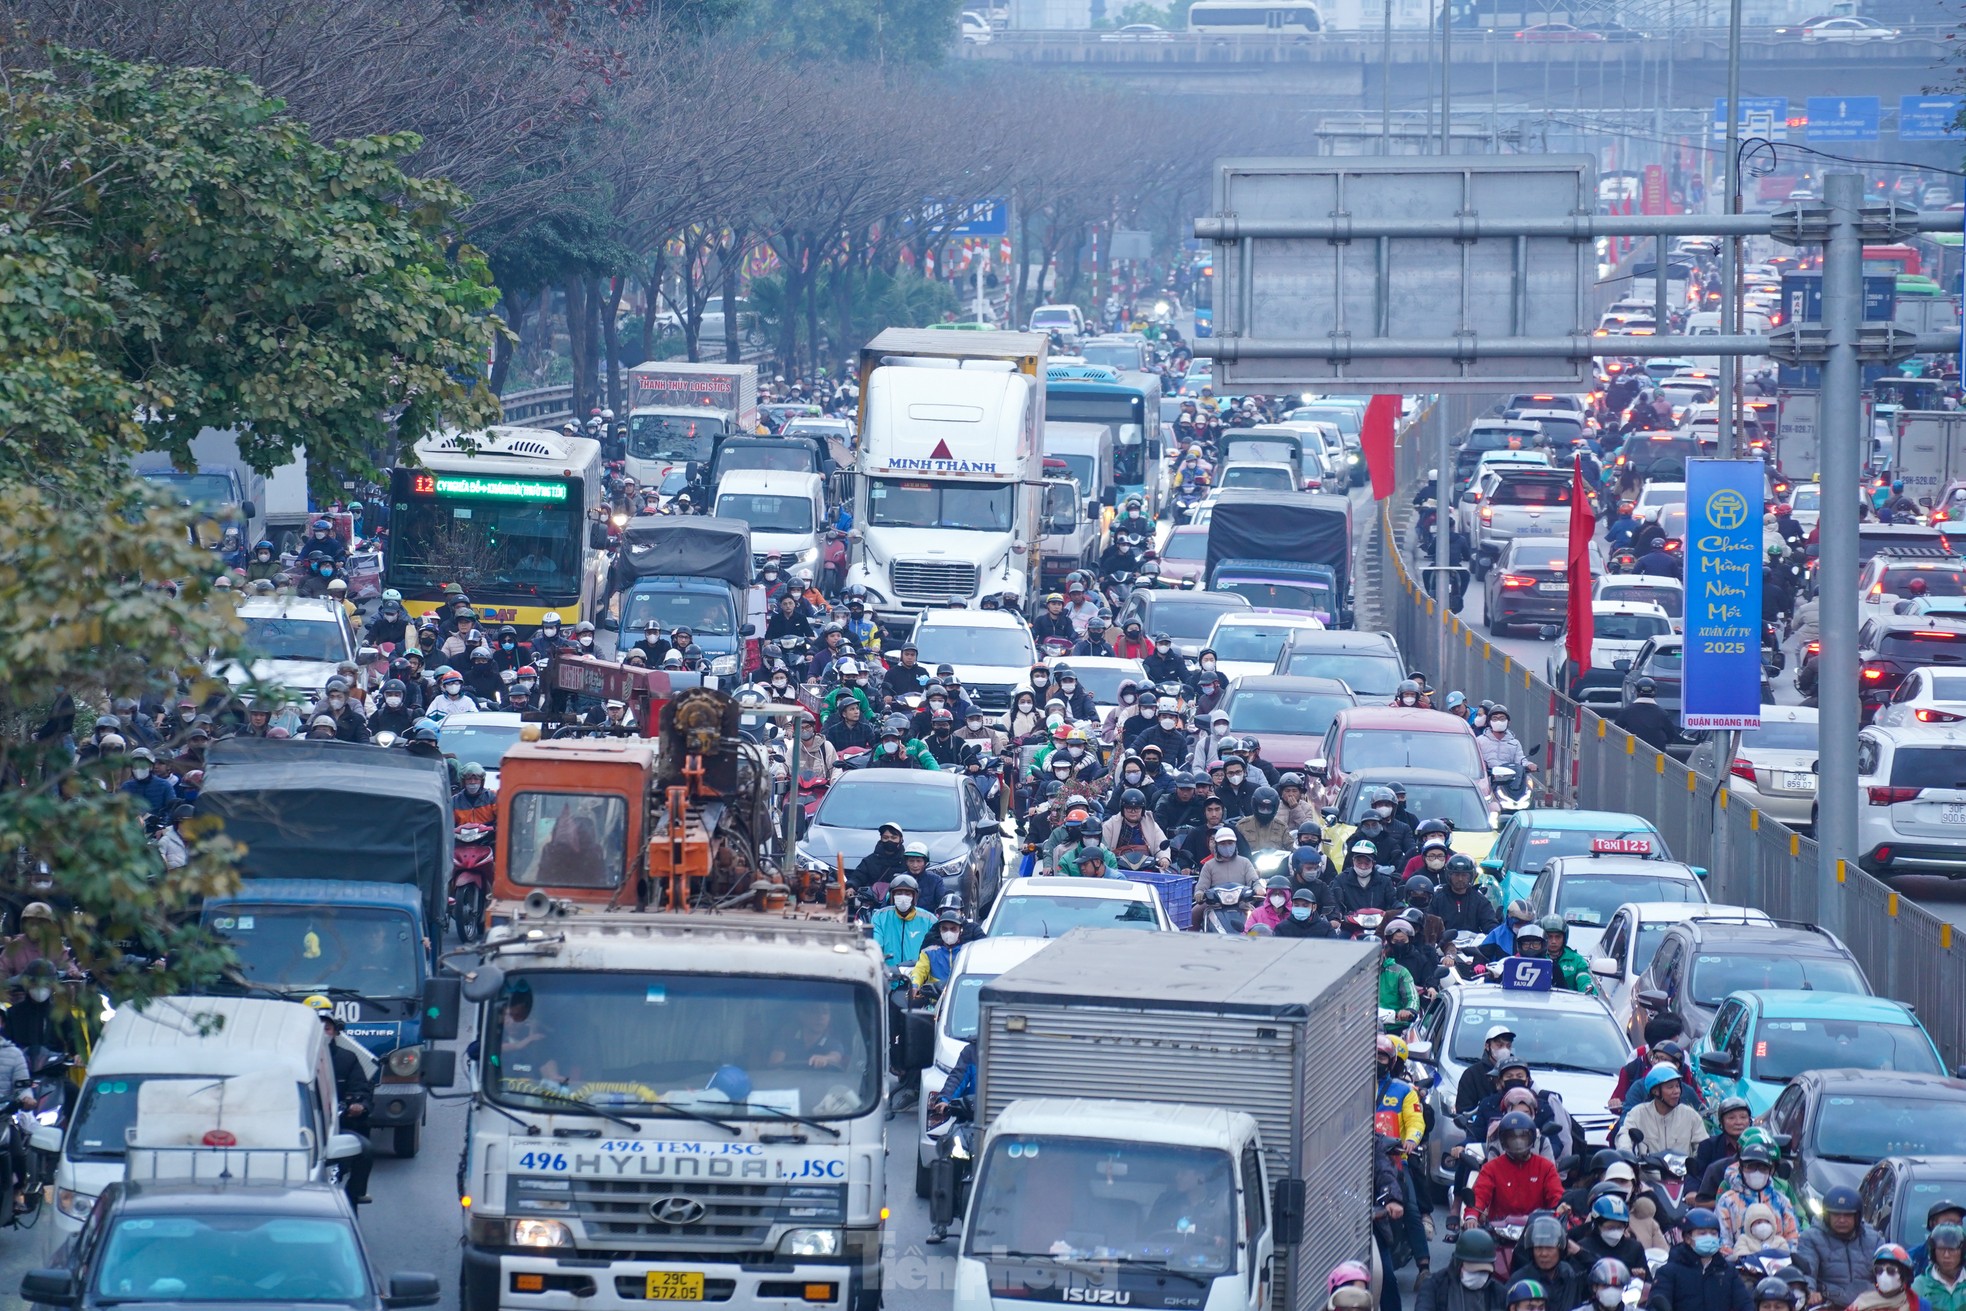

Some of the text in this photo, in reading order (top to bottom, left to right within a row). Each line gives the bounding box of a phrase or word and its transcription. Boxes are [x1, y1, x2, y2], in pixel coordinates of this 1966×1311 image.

[640, 379, 667, 390] THANH
[690, 381, 732, 393] LOGISTICS
[888, 457, 996, 473] MINH THÀNH
[415, 475, 435, 493] 12
[1697, 535, 1755, 553] Chúc
[1701, 555, 1751, 587] Mừng
[1705, 579, 1746, 599] Năm
[1708, 602, 1742, 622] Mới
[1698, 624, 1725, 637] XUÂN
[1703, 641, 1746, 654] 2025
[1687, 716, 1711, 728] QUẬN
[1713, 716, 1742, 727] HOÀNG
[1793, 773, 1807, 782] 30G
[1948, 804, 1965, 814] 30F
[1942, 813, 1966, 823] 900.6
[1595, 838, 1649, 852] Taxi 123
[1515, 961, 1542, 987] G7
[1562, 964, 1575, 972] Grab
[346, 1029, 395, 1037] RONTIER
[600, 1141, 645, 1153] 496
[518, 1151, 568, 1172] 496
[575, 1154, 783, 1179] HYUNDAI
[663, 1273, 688, 1286] 29C
[652, 1286, 697, 1300] 572.05
[1062, 1286, 1131, 1306] ISUZU
[1163, 1296, 1201, 1306] QKR
